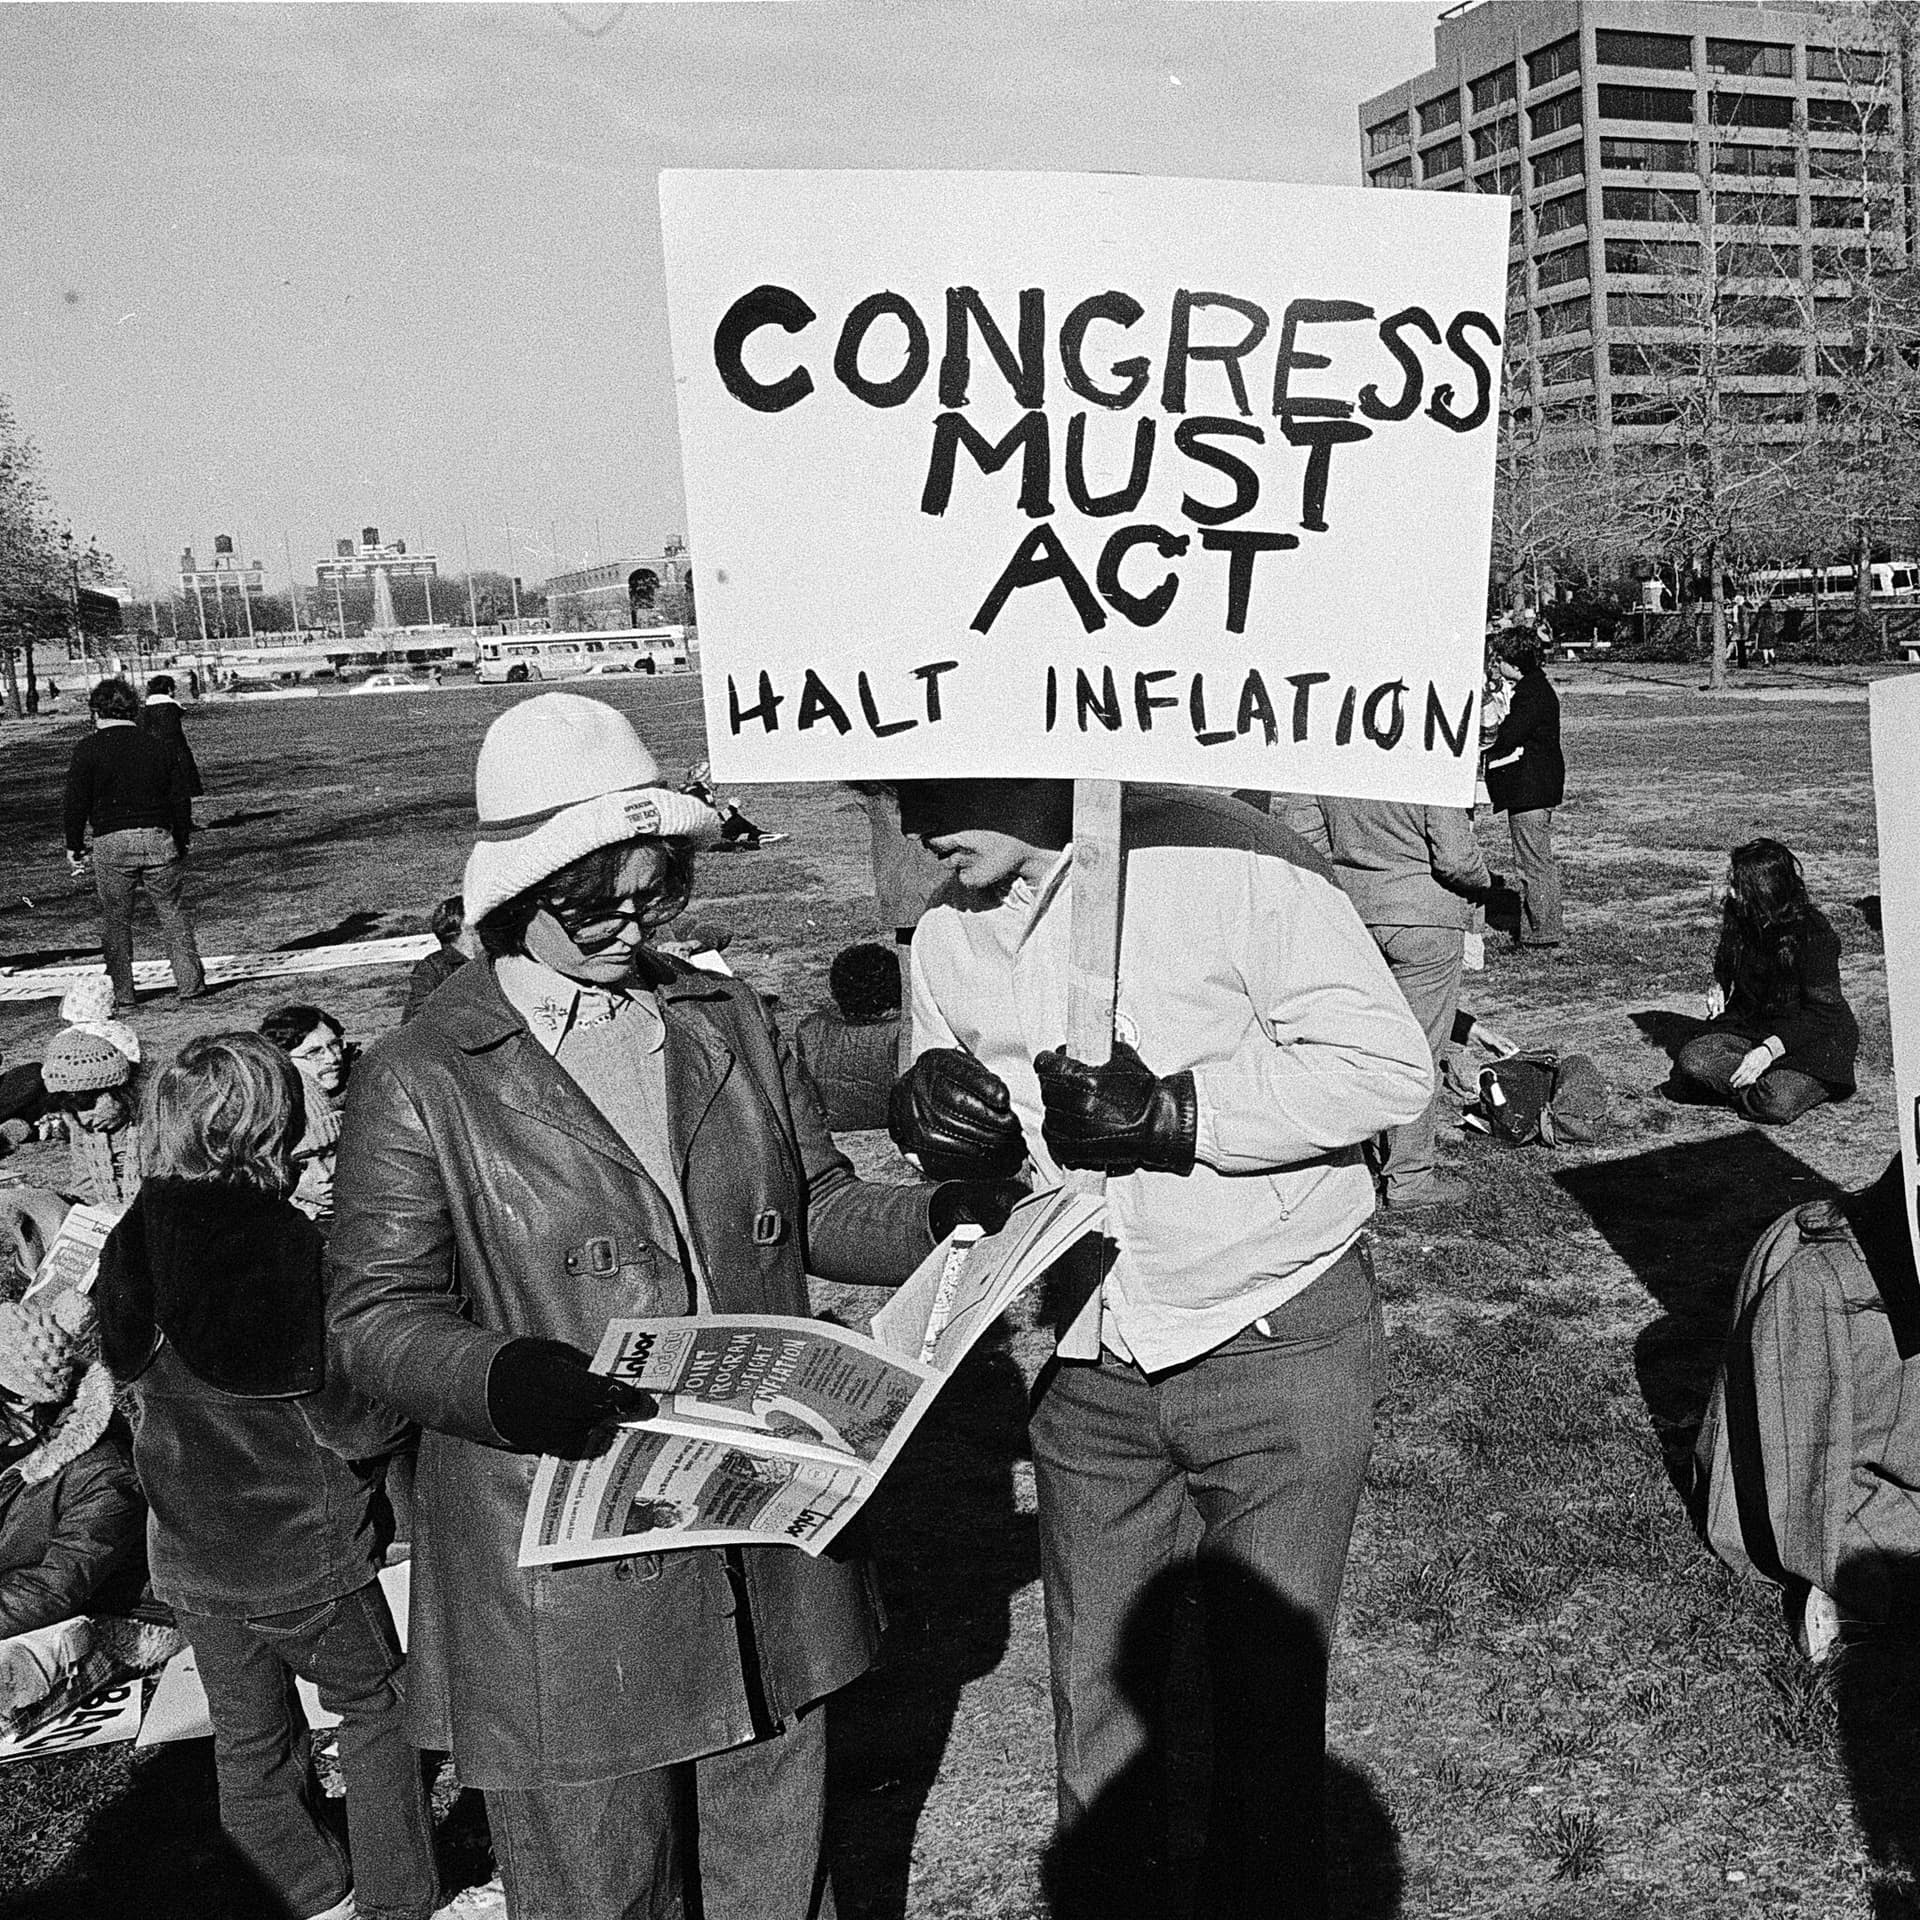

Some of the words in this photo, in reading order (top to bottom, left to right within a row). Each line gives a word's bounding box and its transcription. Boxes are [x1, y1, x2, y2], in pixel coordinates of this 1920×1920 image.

[713, 284, 1502, 432] CONGRESS
[921, 410, 1374, 531] MUST
[969, 524, 1299, 633] ACT
[728, 661, 958, 738] HALT
[1046, 664, 1475, 758] INFLATION
[682, 1350, 719, 1395] POINT
[707, 1333, 757, 1399] PROGRAM
[742, 1344, 774, 1380] FIGHT
[753, 1338, 808, 1403] INFLATION
